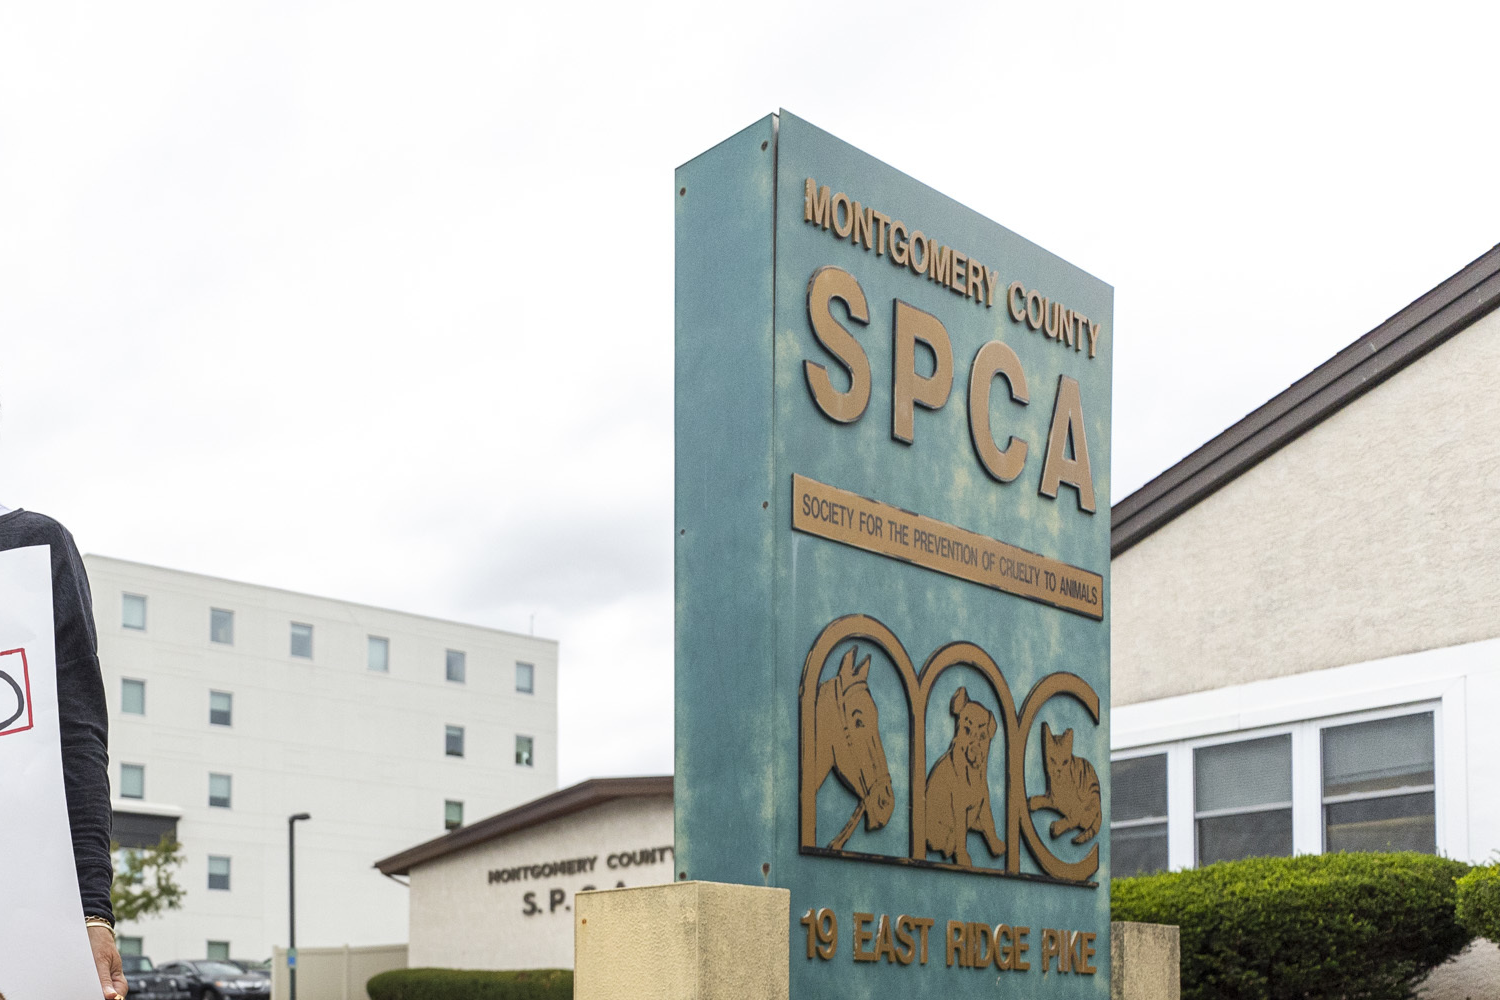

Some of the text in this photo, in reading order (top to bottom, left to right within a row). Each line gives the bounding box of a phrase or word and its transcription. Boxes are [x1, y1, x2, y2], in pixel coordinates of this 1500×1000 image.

[803, 177, 1100, 359] MONTGOMERY COUNTY
[803, 265, 1097, 515] SPCA
[803, 493, 1098, 605] SOCIETY FOR THE PREVENTION OF CRUELTY TO ANIMALS
[488, 856, 598, 885] MONTGOMERY
[801, 908, 1097, 974] 19 EAST RIDGE PIKE
